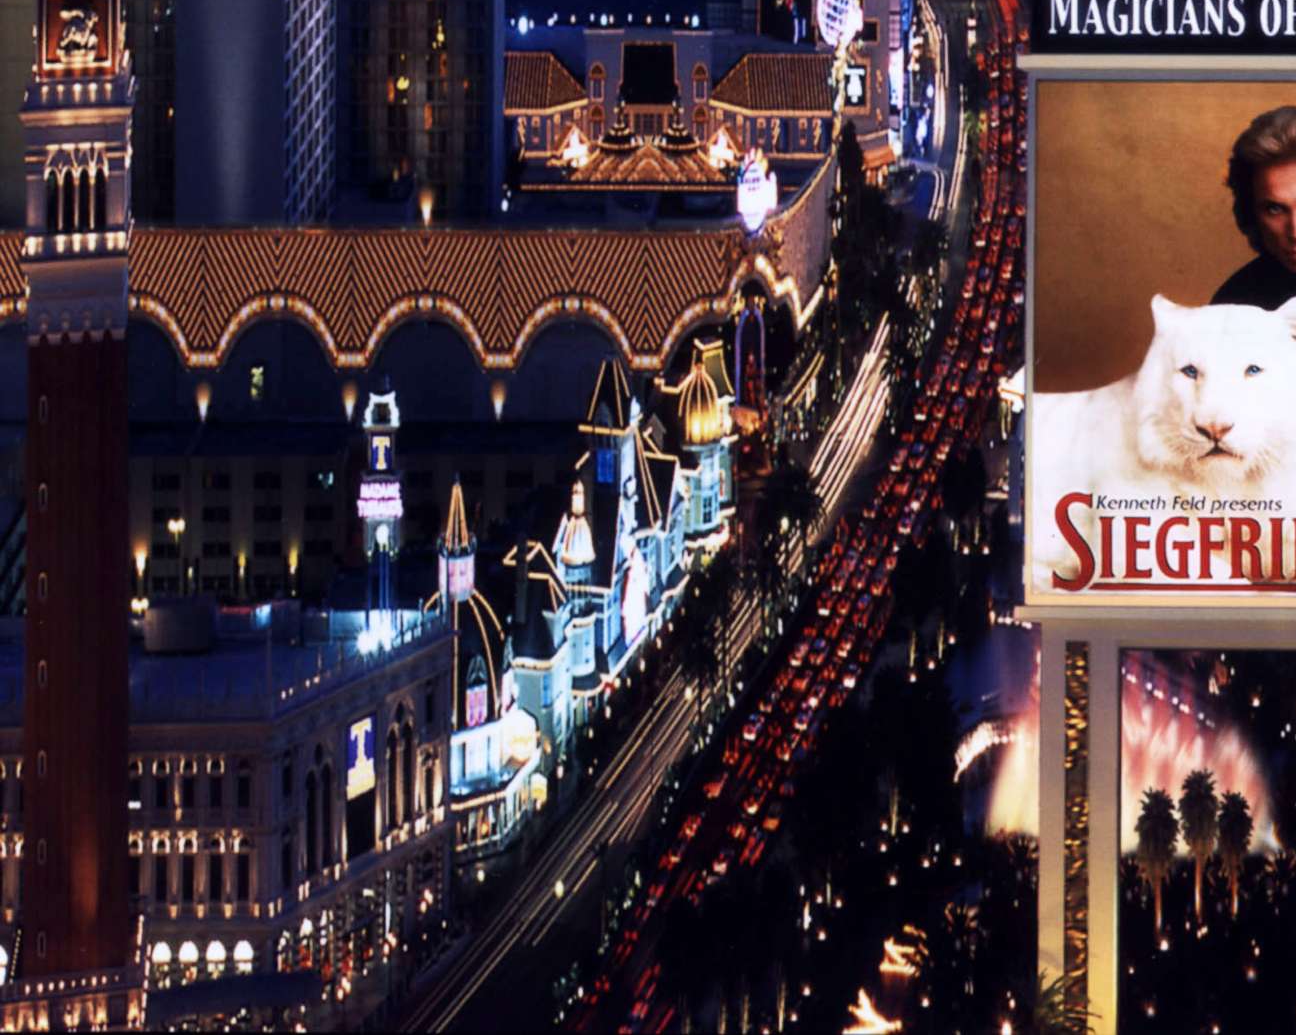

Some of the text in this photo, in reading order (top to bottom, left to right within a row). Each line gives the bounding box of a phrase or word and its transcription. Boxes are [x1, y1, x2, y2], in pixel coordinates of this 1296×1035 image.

[1095, 494, 1283, 513] Kenneth Feld presents
